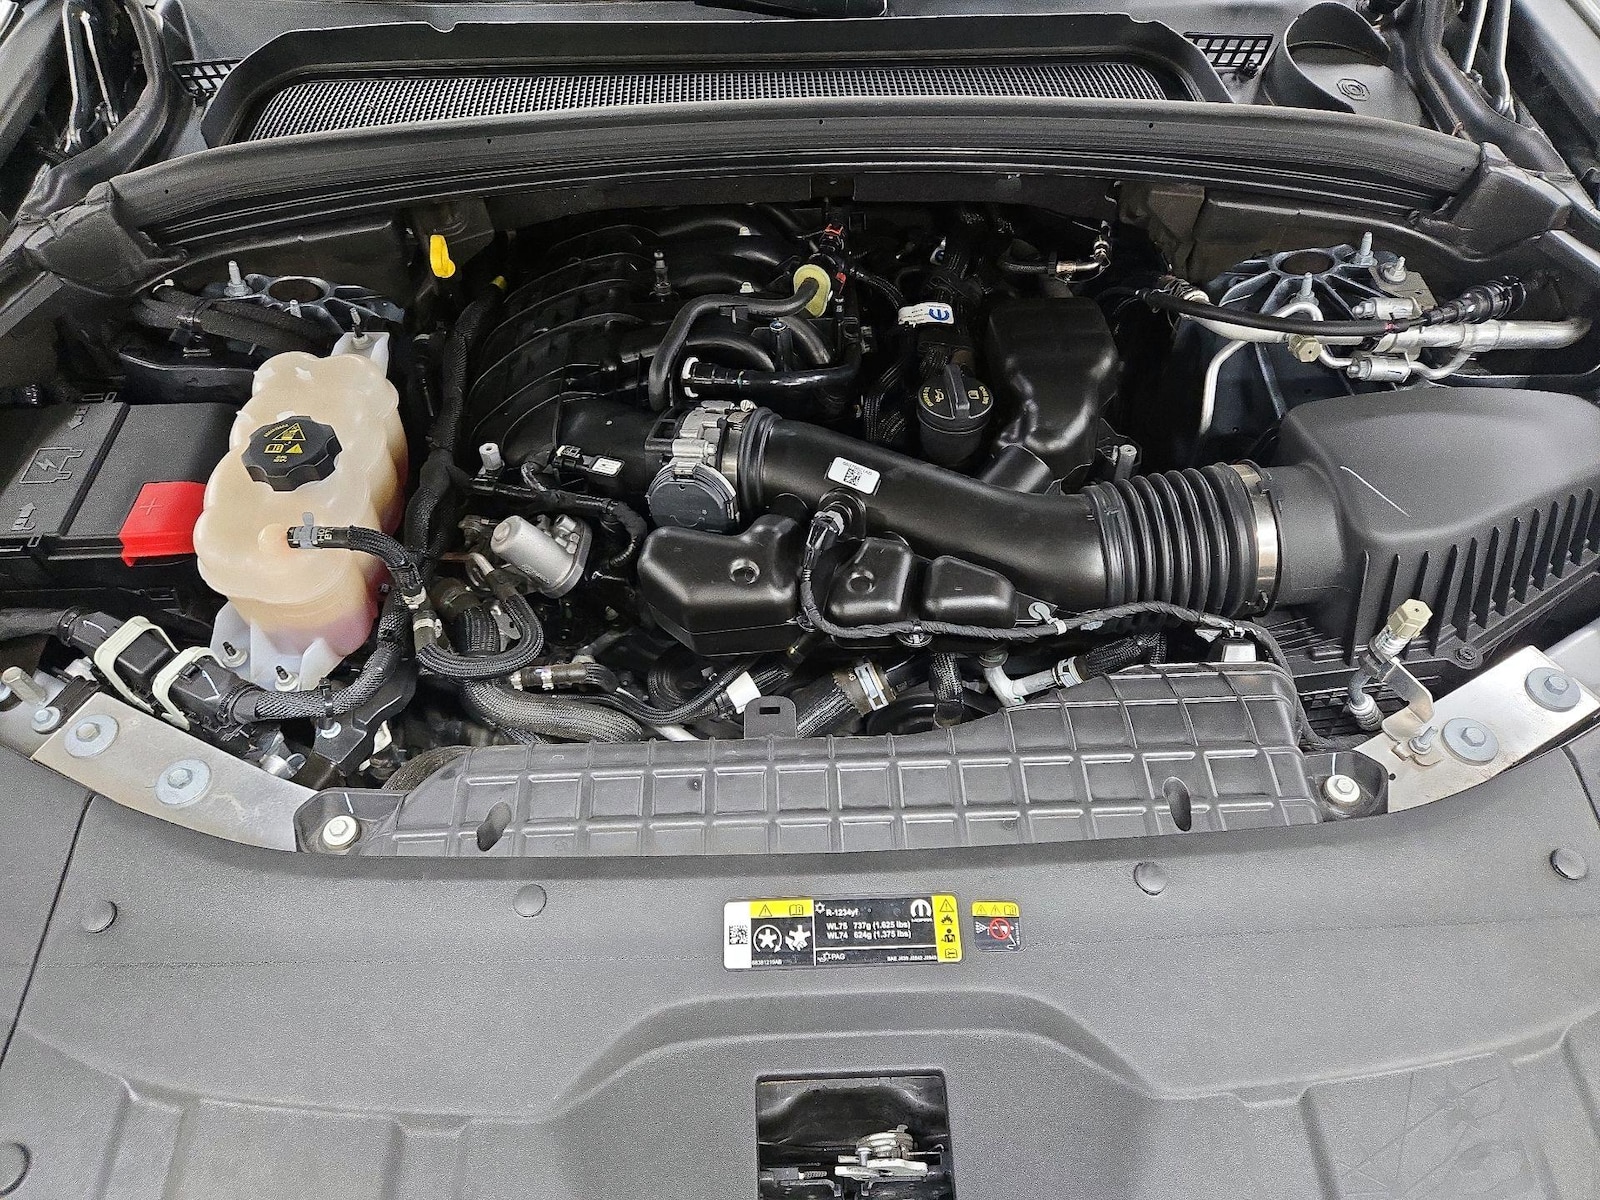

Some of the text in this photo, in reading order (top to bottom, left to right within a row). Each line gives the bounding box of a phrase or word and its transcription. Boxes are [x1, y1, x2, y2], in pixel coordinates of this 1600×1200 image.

[853, 921, 872, 931] 737g
[826, 931, 849, 940] WL74
[853, 930, 872, 940] 624g
[873, 930, 896, 939] (1.375
